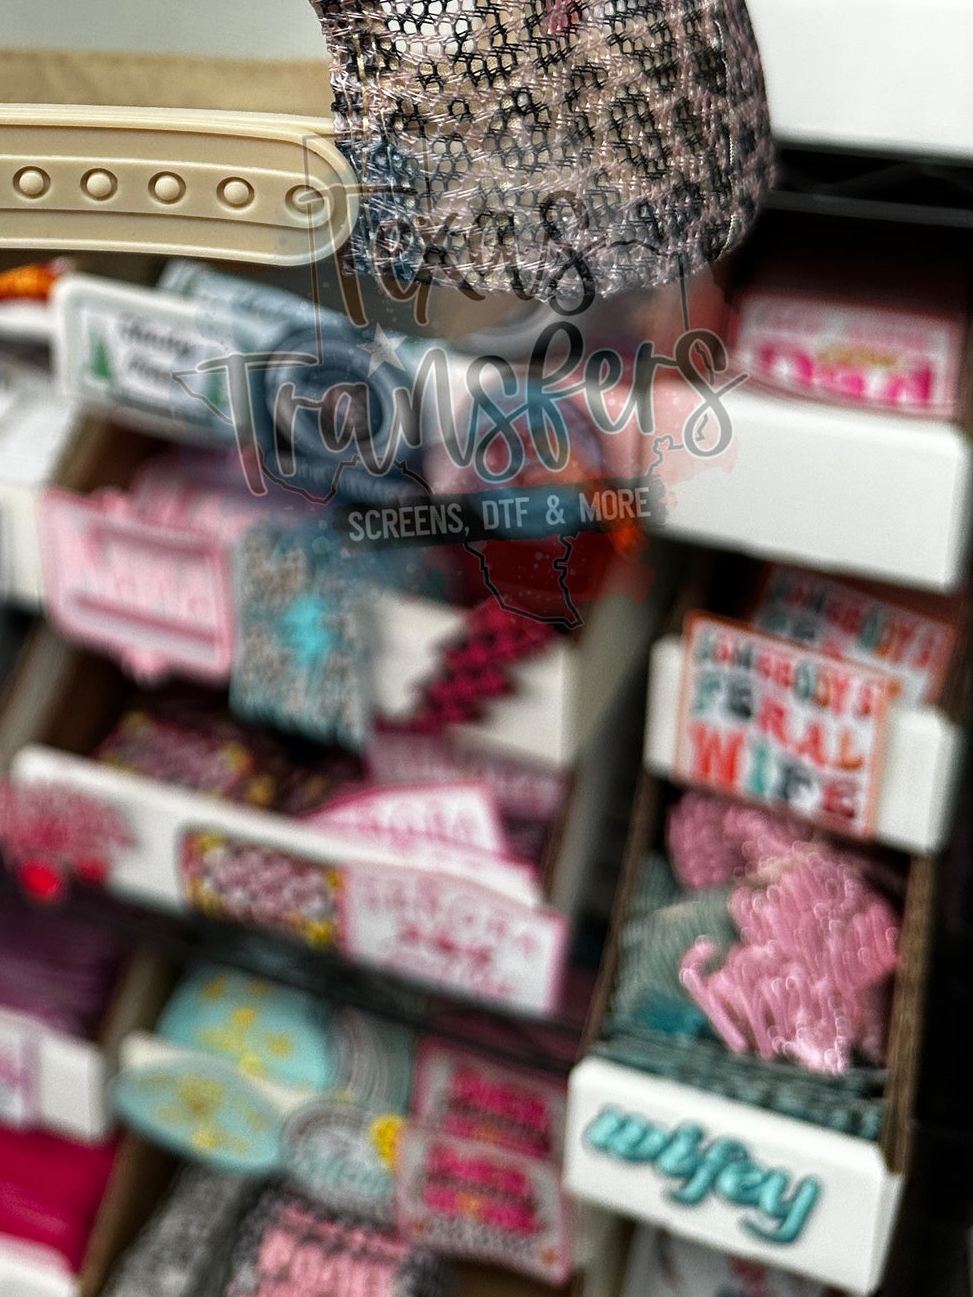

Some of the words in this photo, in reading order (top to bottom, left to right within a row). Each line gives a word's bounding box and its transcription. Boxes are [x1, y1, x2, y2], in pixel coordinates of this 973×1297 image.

[688, 721, 861, 821] WIFE
[691, 666, 868, 771] FERAL
[589, 1107, 819, 1244] wifey
